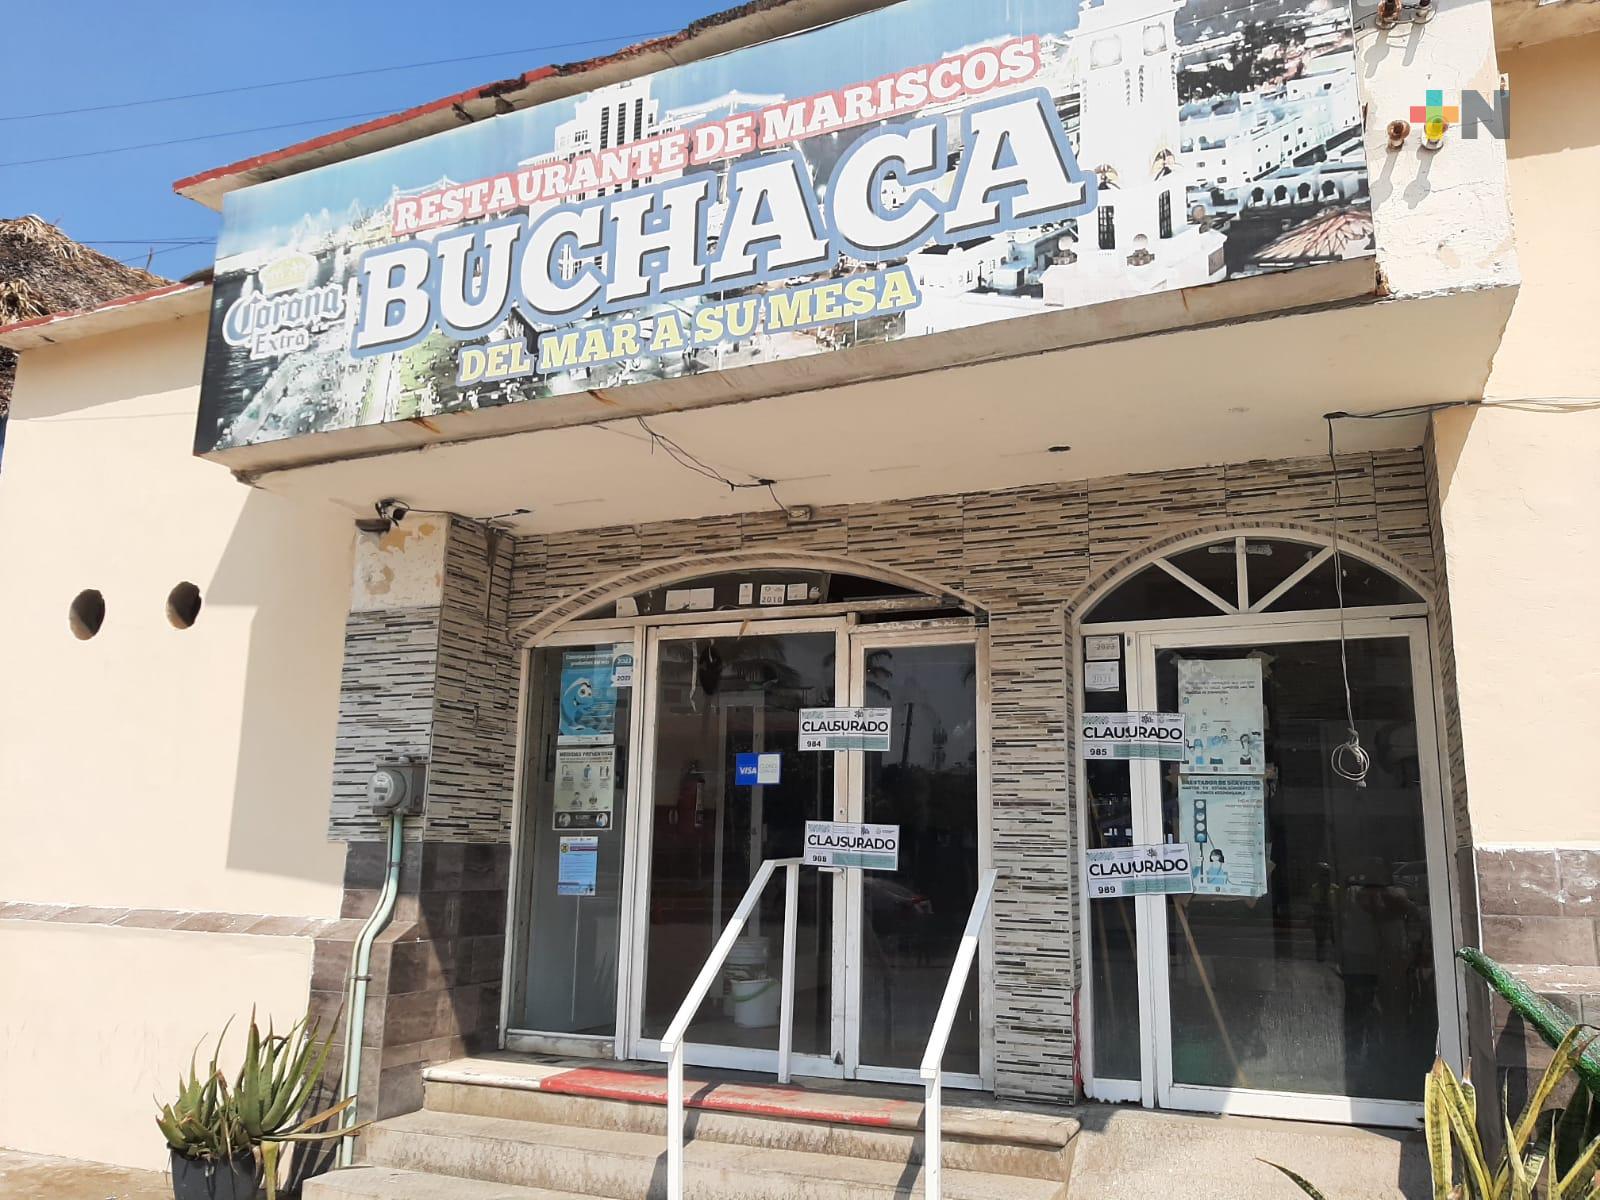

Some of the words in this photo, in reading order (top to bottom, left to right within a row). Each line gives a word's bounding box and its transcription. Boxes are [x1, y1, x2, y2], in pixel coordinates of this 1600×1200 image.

[394, 132, 687, 231] RESTAURANTE
[694, 115, 754, 159] DE
[761, 39, 1036, 145] MARISCOS
[356, 96, 1087, 349] BUCHACA
[224, 285, 341, 342] Corona
[460, 342, 531, 381] DEL
[540, 323, 641, 368] MAR
[649, 316, 683, 351] A
[695, 301, 758, 342] SU
[768, 270, 918, 329] MESA
[254, 331, 306, 355] Extra
[801, 720, 889, 732] CLAUSURADO
[806, 740, 821, 748] 984
[1089, 748, 1107, 756] 985
[739, 766, 757, 775] VISA
[1097, 886, 1116, 894] 989
